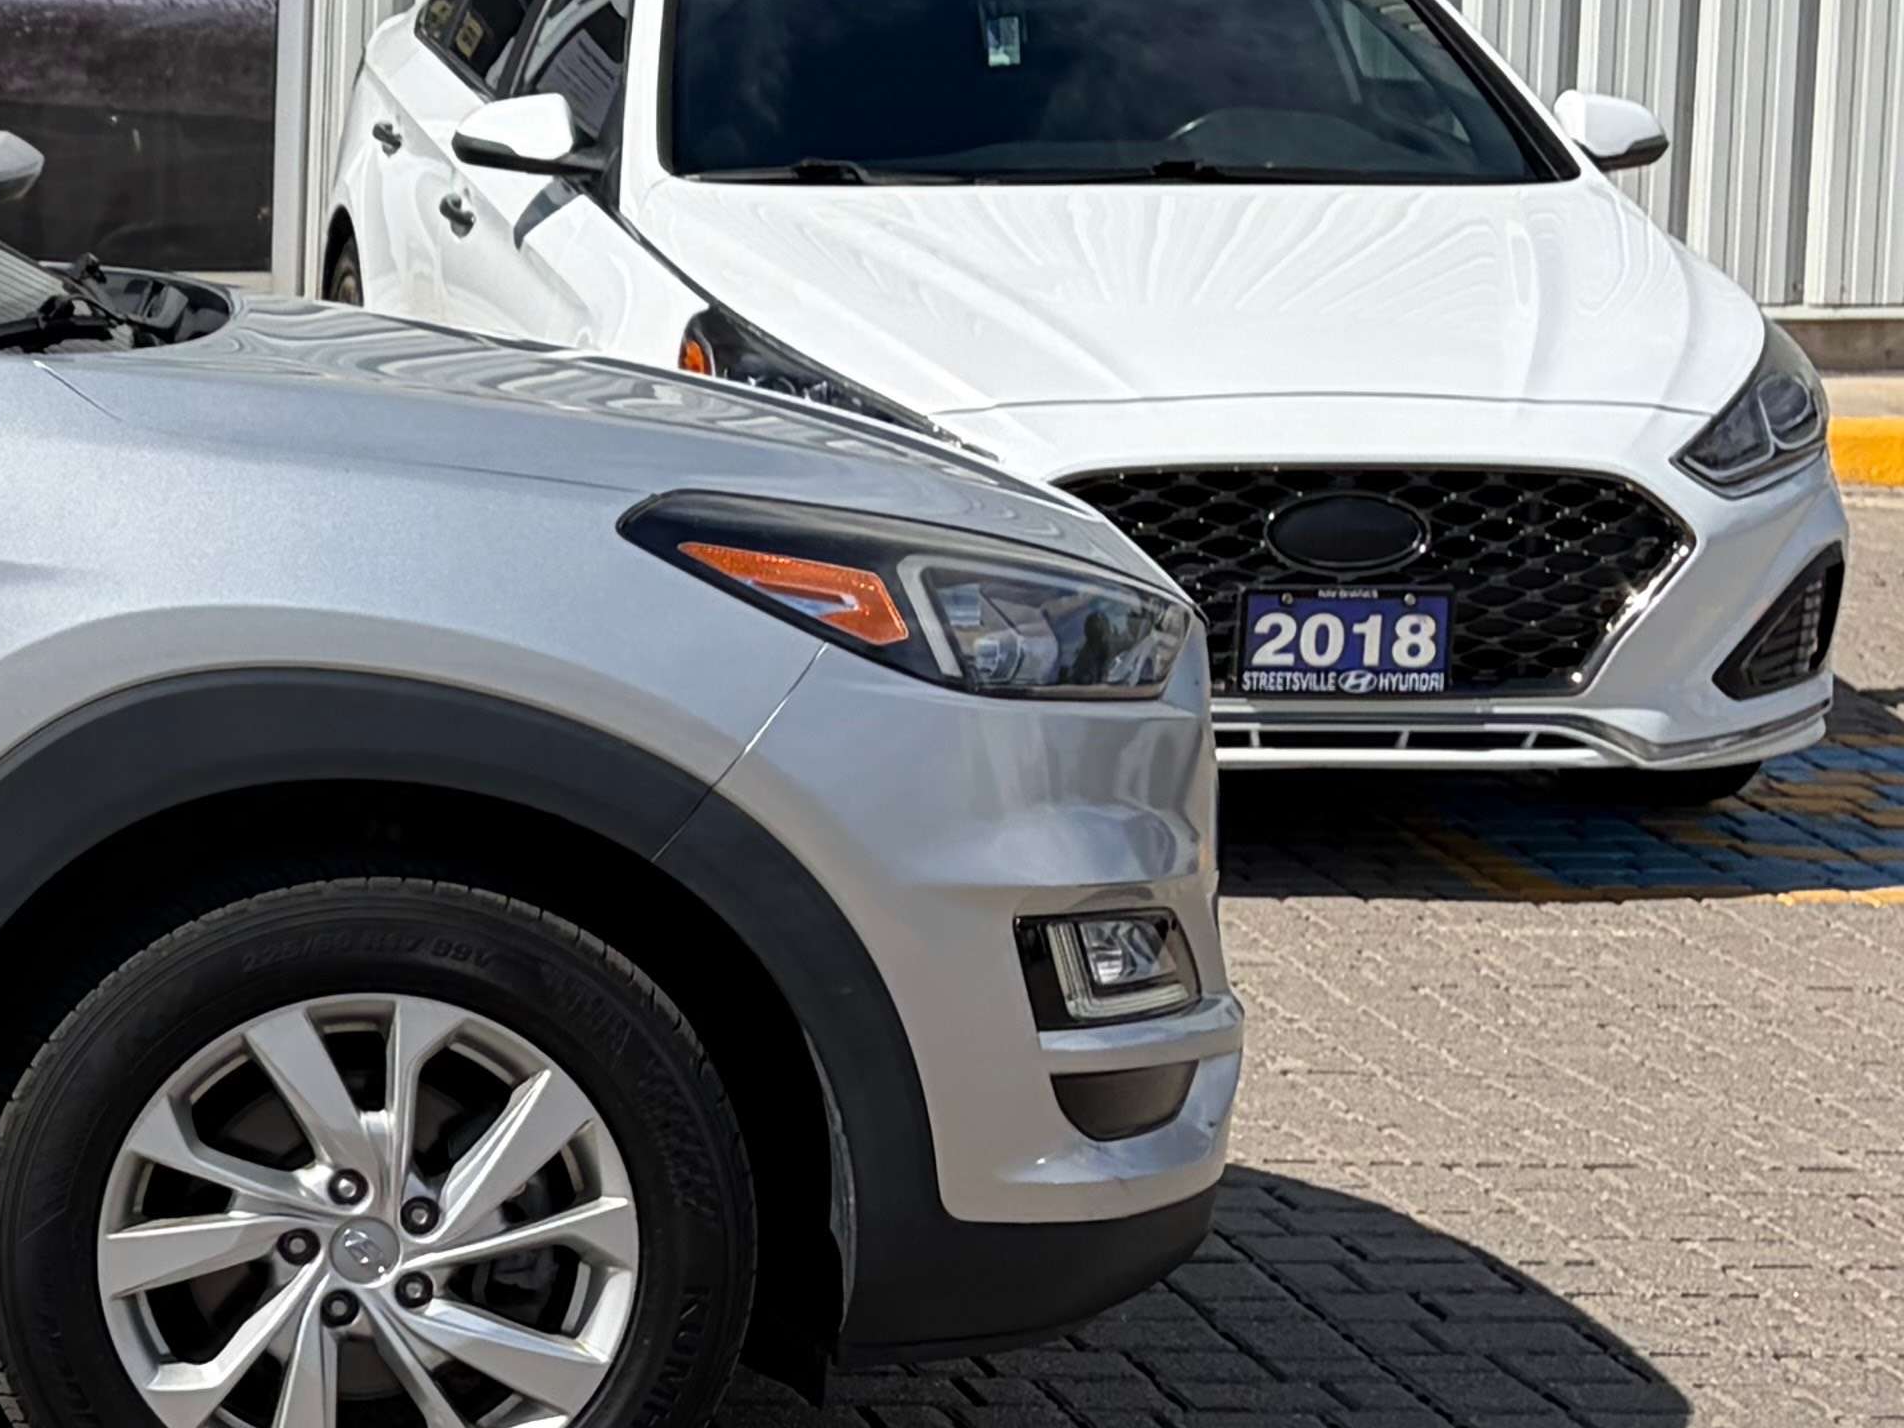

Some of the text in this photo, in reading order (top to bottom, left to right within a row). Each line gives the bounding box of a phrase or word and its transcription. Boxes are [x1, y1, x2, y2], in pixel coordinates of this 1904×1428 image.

[1251, 612, 1437, 668] 2018
[1242, 671, 1444, 692] STREETSVILLE HYUNDAI
